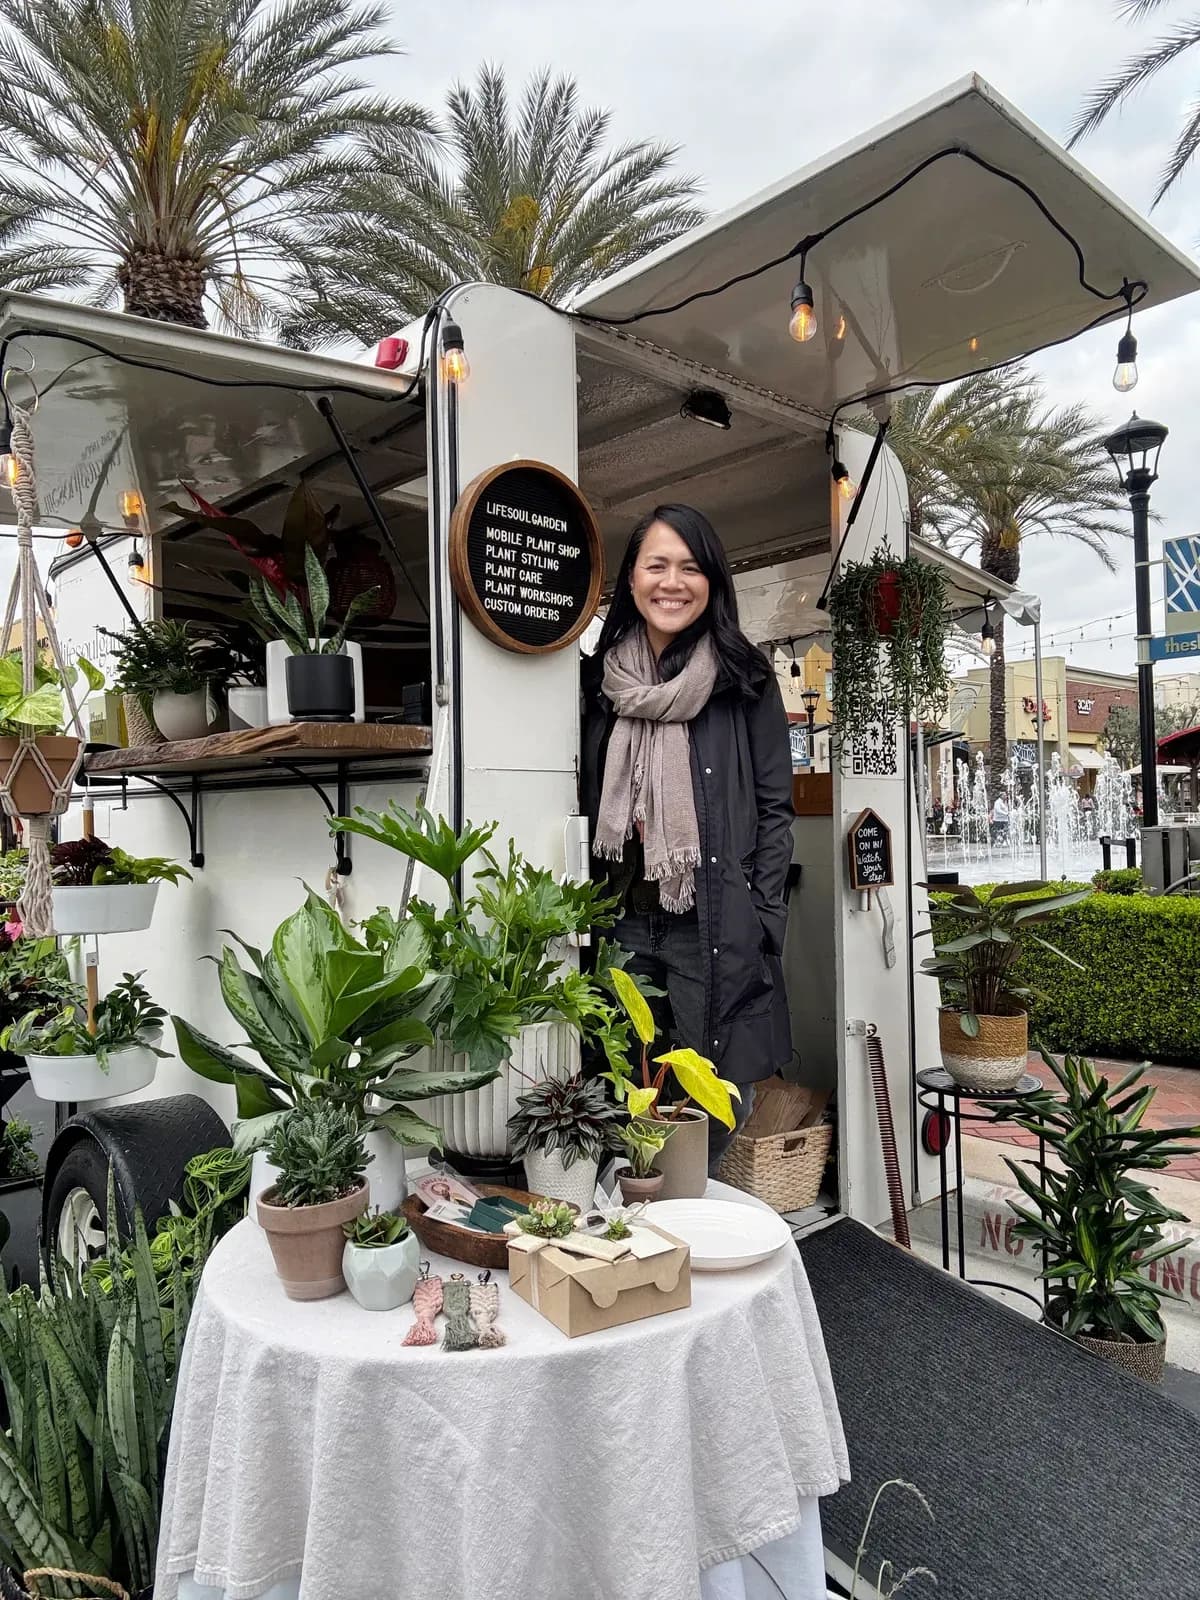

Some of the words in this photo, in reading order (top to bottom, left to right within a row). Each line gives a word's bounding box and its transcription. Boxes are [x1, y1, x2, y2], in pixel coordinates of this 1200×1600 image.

[486, 501, 568, 532] LIFESOULGARDEN
[486, 526, 523, 546] MOBILE
[526, 536, 556, 554] PLANT
[558, 544, 581, 559] SHOP
[486, 544, 517, 562] PLANT
[521, 553, 560, 571] STYLING
[485, 562, 517, 580] PLANT
[519, 569, 543, 585] CARE
[485, 579, 516, 597] PLANT
[520, 586, 574, 607] WORKSHOPS
[484, 598, 521, 615] CUSTOM
[524, 606, 560, 622] ORDERS
[858, 827, 878, 838] COME
[859, 842, 870, 850] ON
[873, 840, 882, 848] IN!
[856, 852, 881, 864] Watch
[862, 864, 882, 876] your
[868, 871, 886, 883] step!
[980, 1211, 1024, 1256] NO
